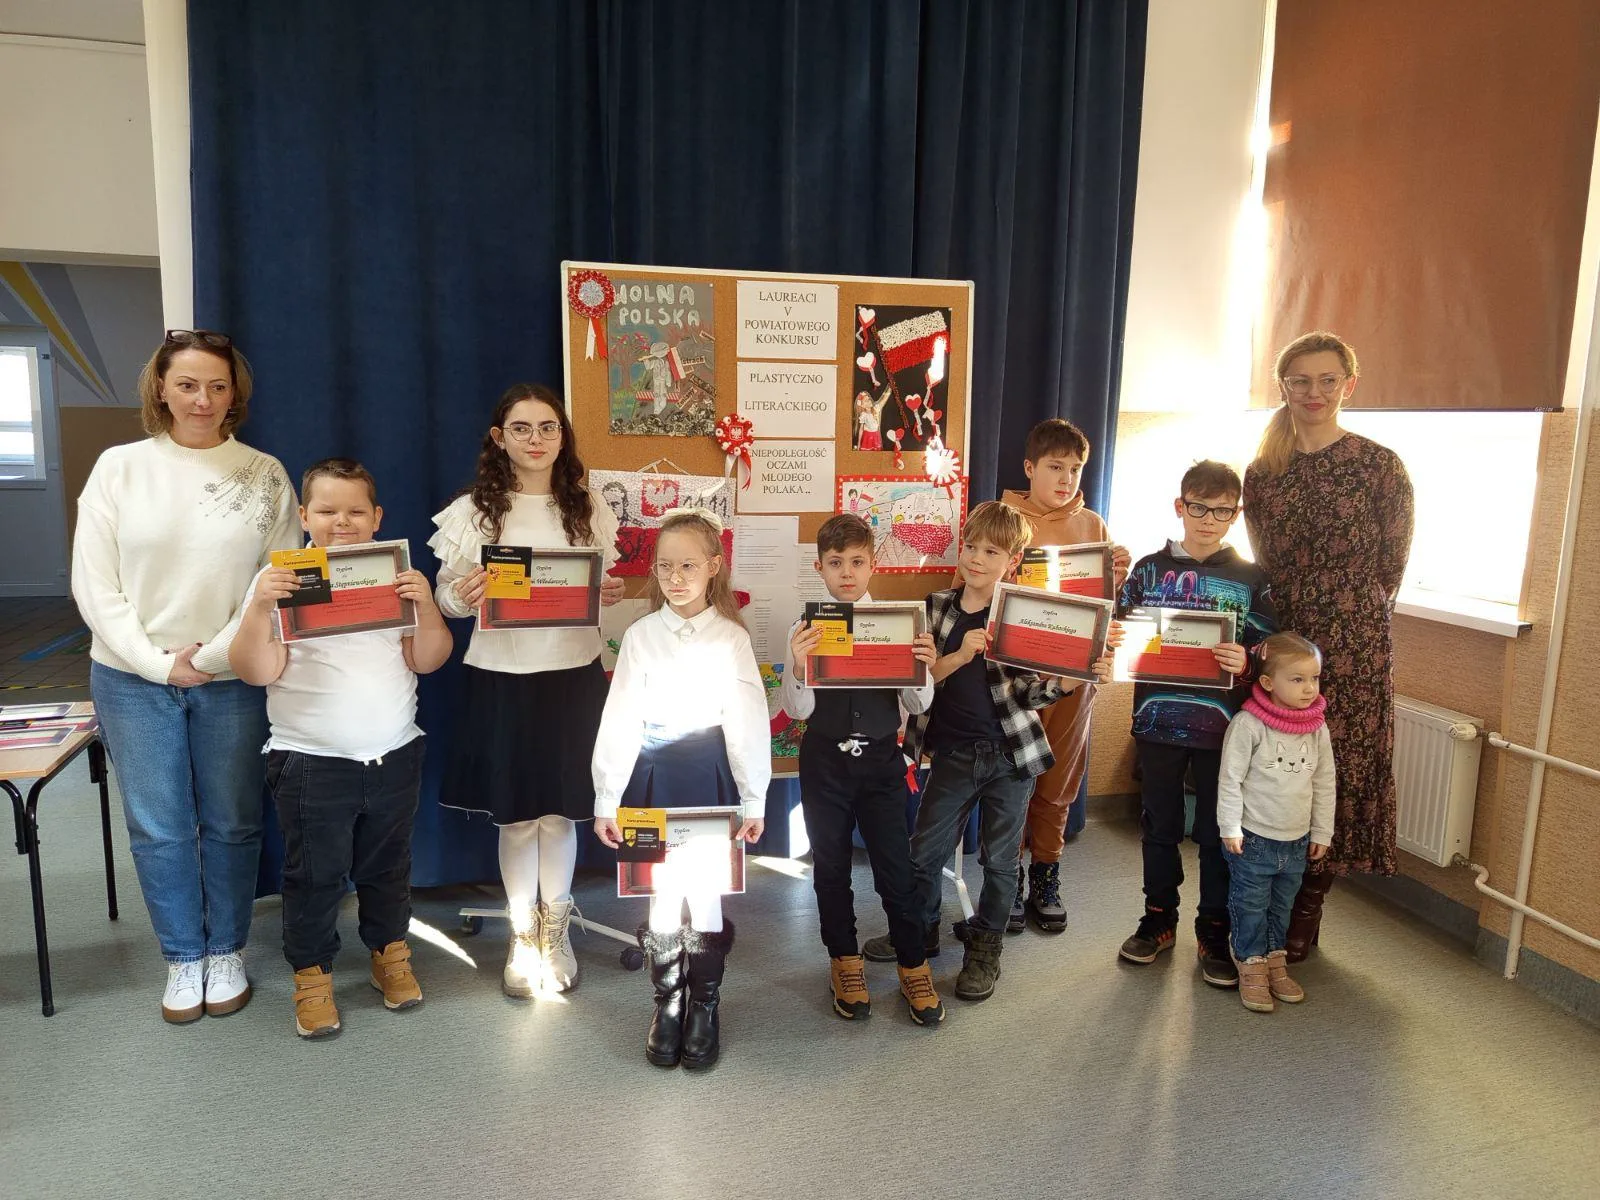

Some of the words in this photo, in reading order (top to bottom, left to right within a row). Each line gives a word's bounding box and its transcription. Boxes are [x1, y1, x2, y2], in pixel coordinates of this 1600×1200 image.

[759, 291, 817, 304] LAUREACI
[784, 306, 793, 317] V
[619, 307, 700, 329] POLSKA
[744, 319, 831, 332] POWIATOWEGO
[755, 334, 819, 346] KONKURSU
[749, 372, 824, 385] PLASTYCZNO
[744, 400, 828, 412] LITERACKIEGO
[766, 460, 807, 470] OCZAMI
[761, 472, 813, 482] MŁODEGO
